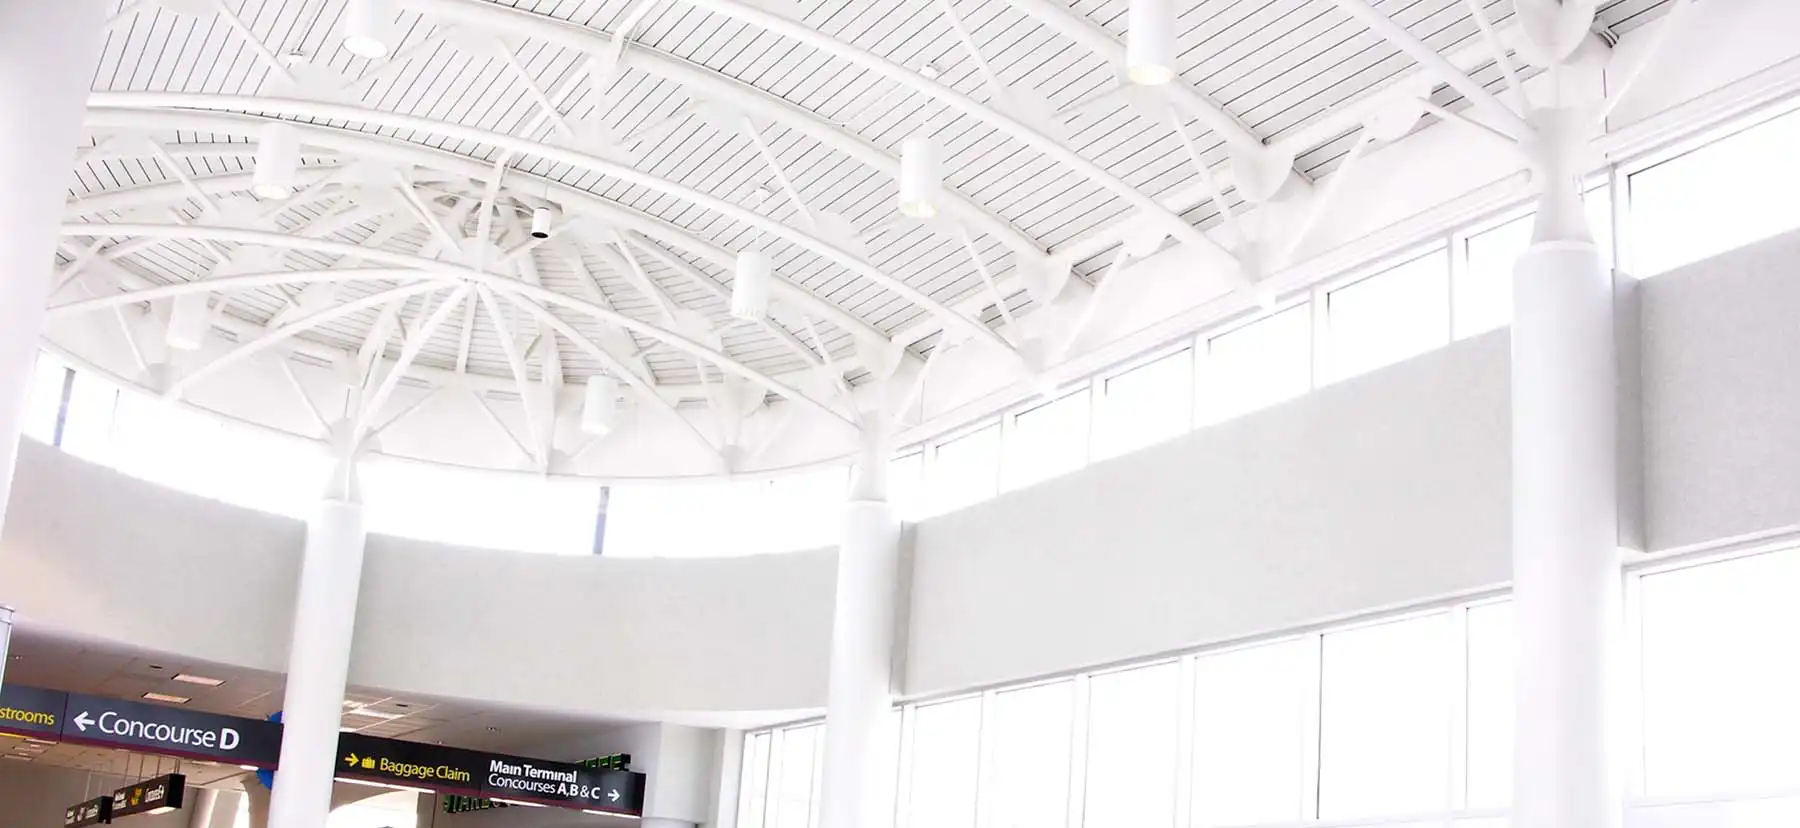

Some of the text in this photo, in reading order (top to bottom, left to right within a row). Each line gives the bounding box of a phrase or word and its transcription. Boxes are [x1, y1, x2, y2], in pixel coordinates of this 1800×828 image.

[98, 711, 240, 750] Concourse D
[380, 757, 470, 782] Baggage Claim
[489, 759, 577, 783] Main Terminal
[488, 773, 556, 794] Concourses
[580, 785, 590, 798] &
[591, 787, 601, 800] C
